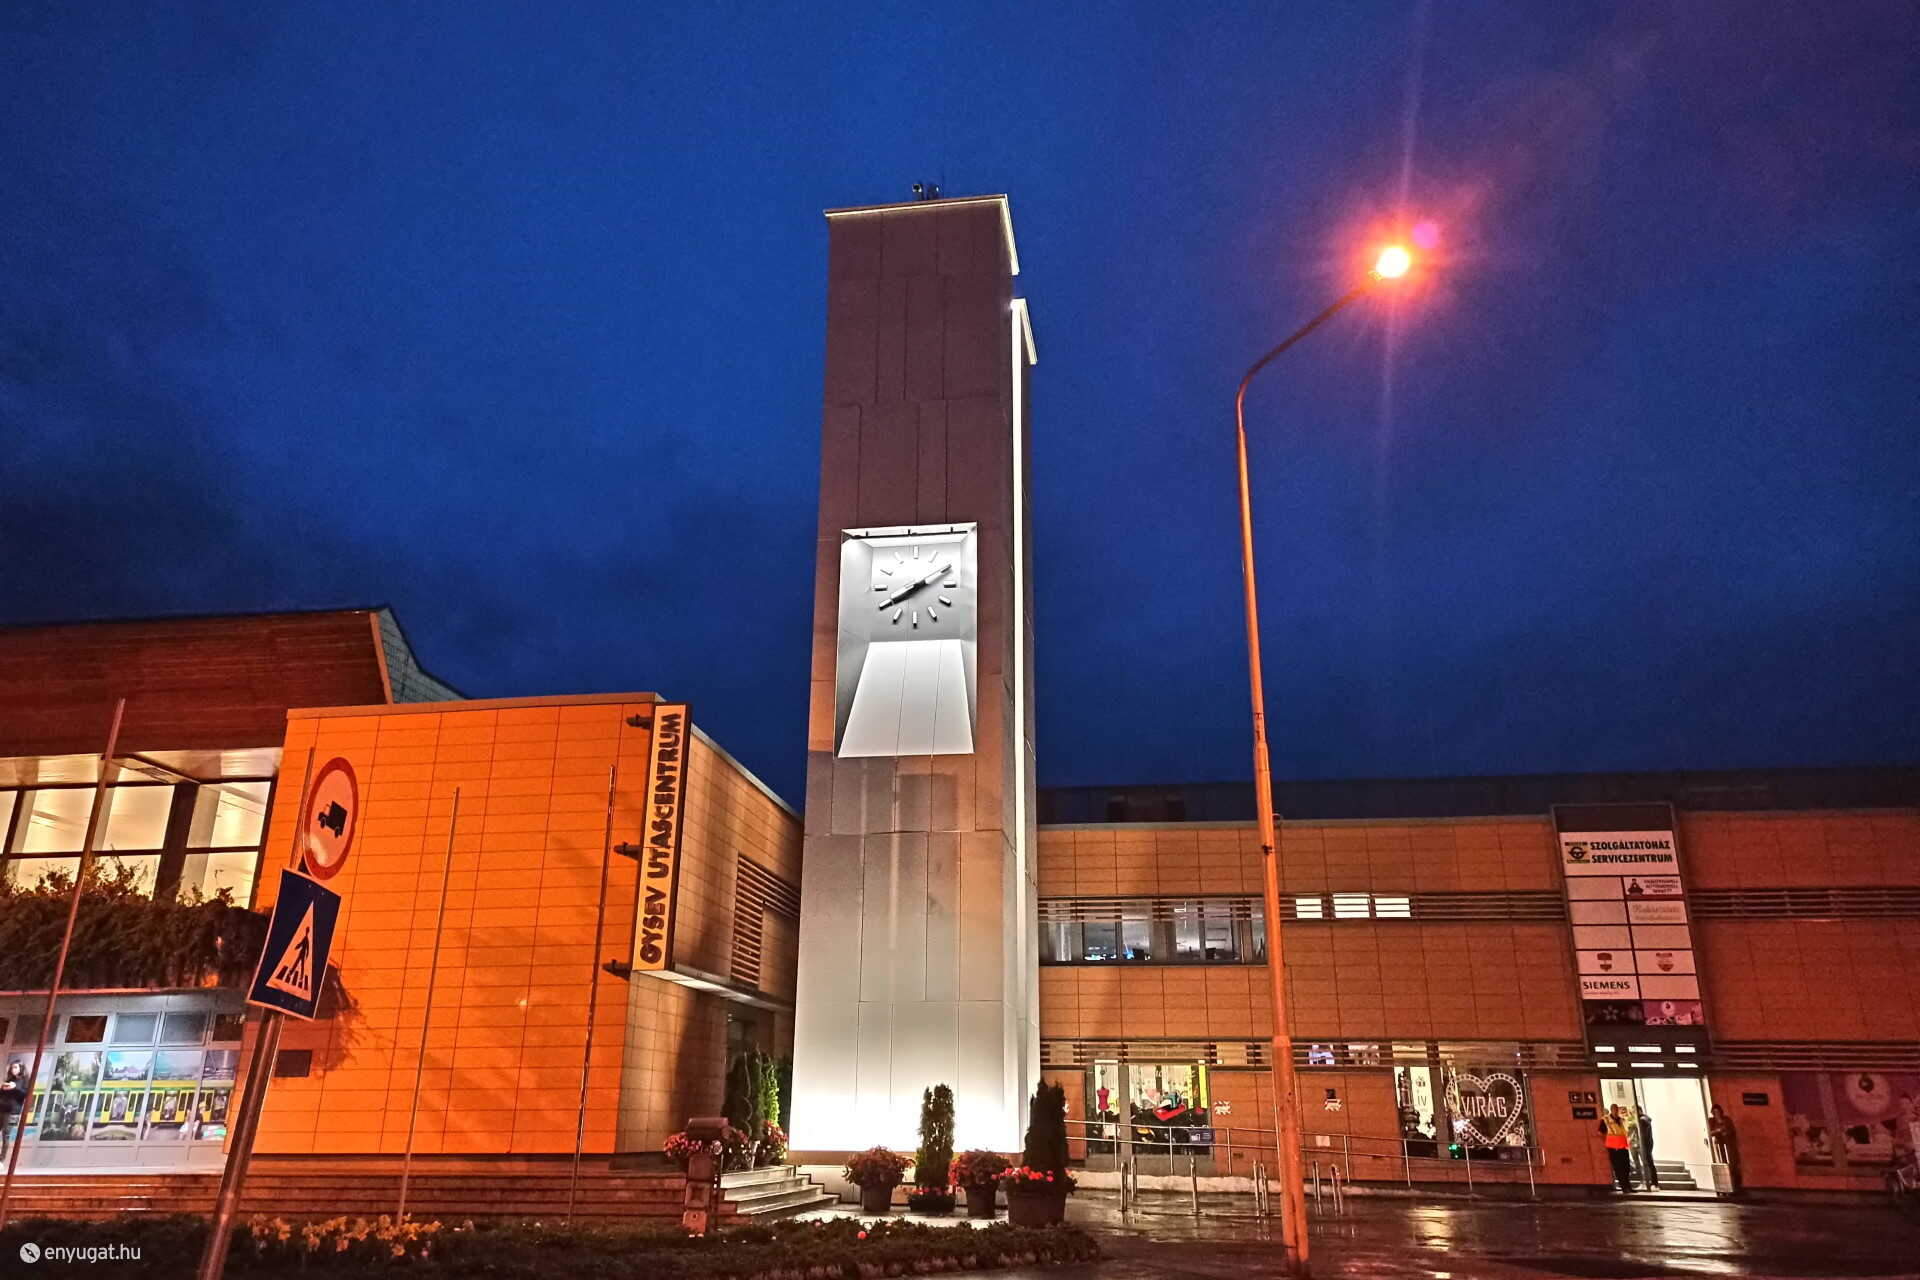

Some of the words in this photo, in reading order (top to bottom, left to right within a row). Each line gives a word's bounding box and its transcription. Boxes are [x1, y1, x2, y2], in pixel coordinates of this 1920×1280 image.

[647, 713, 682, 878] UTASCENTRUM
[1592, 854, 1672, 864] SERVICEZENTRUM
[639, 886, 666, 964] GYSEV
[1583, 981, 1630, 990] SIEMENS
[1461, 1092, 1507, 1118] VIRÁG
